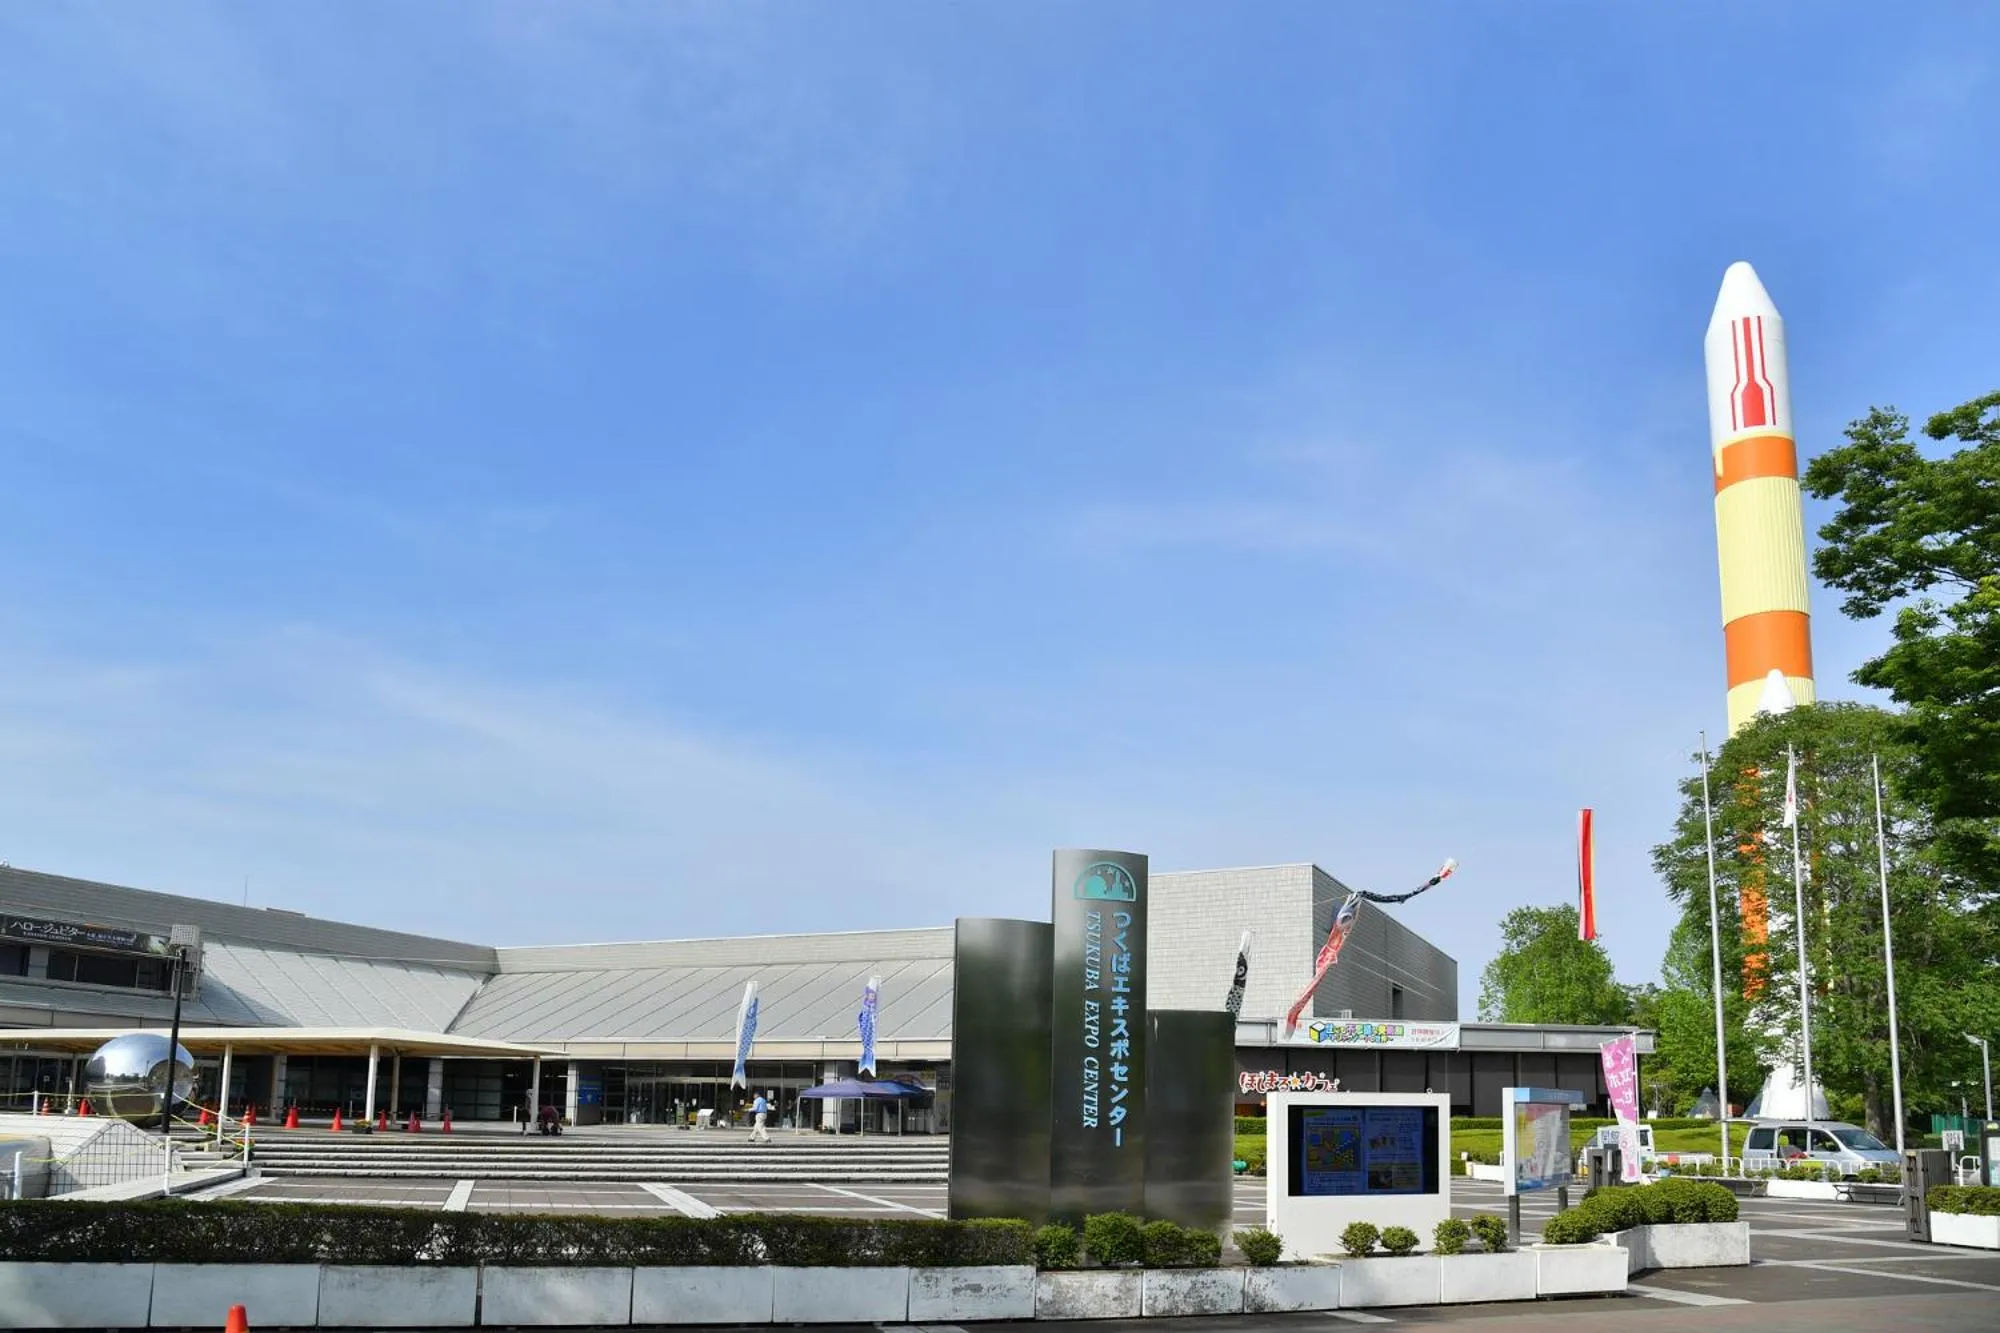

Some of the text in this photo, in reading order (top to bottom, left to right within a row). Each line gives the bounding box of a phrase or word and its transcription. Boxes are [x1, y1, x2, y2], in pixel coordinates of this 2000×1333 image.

[1083, 911, 1101, 1129] TSUKUBA EXPO CENTER
[1109, 911, 1131, 1147] つくばエキスポセンター
